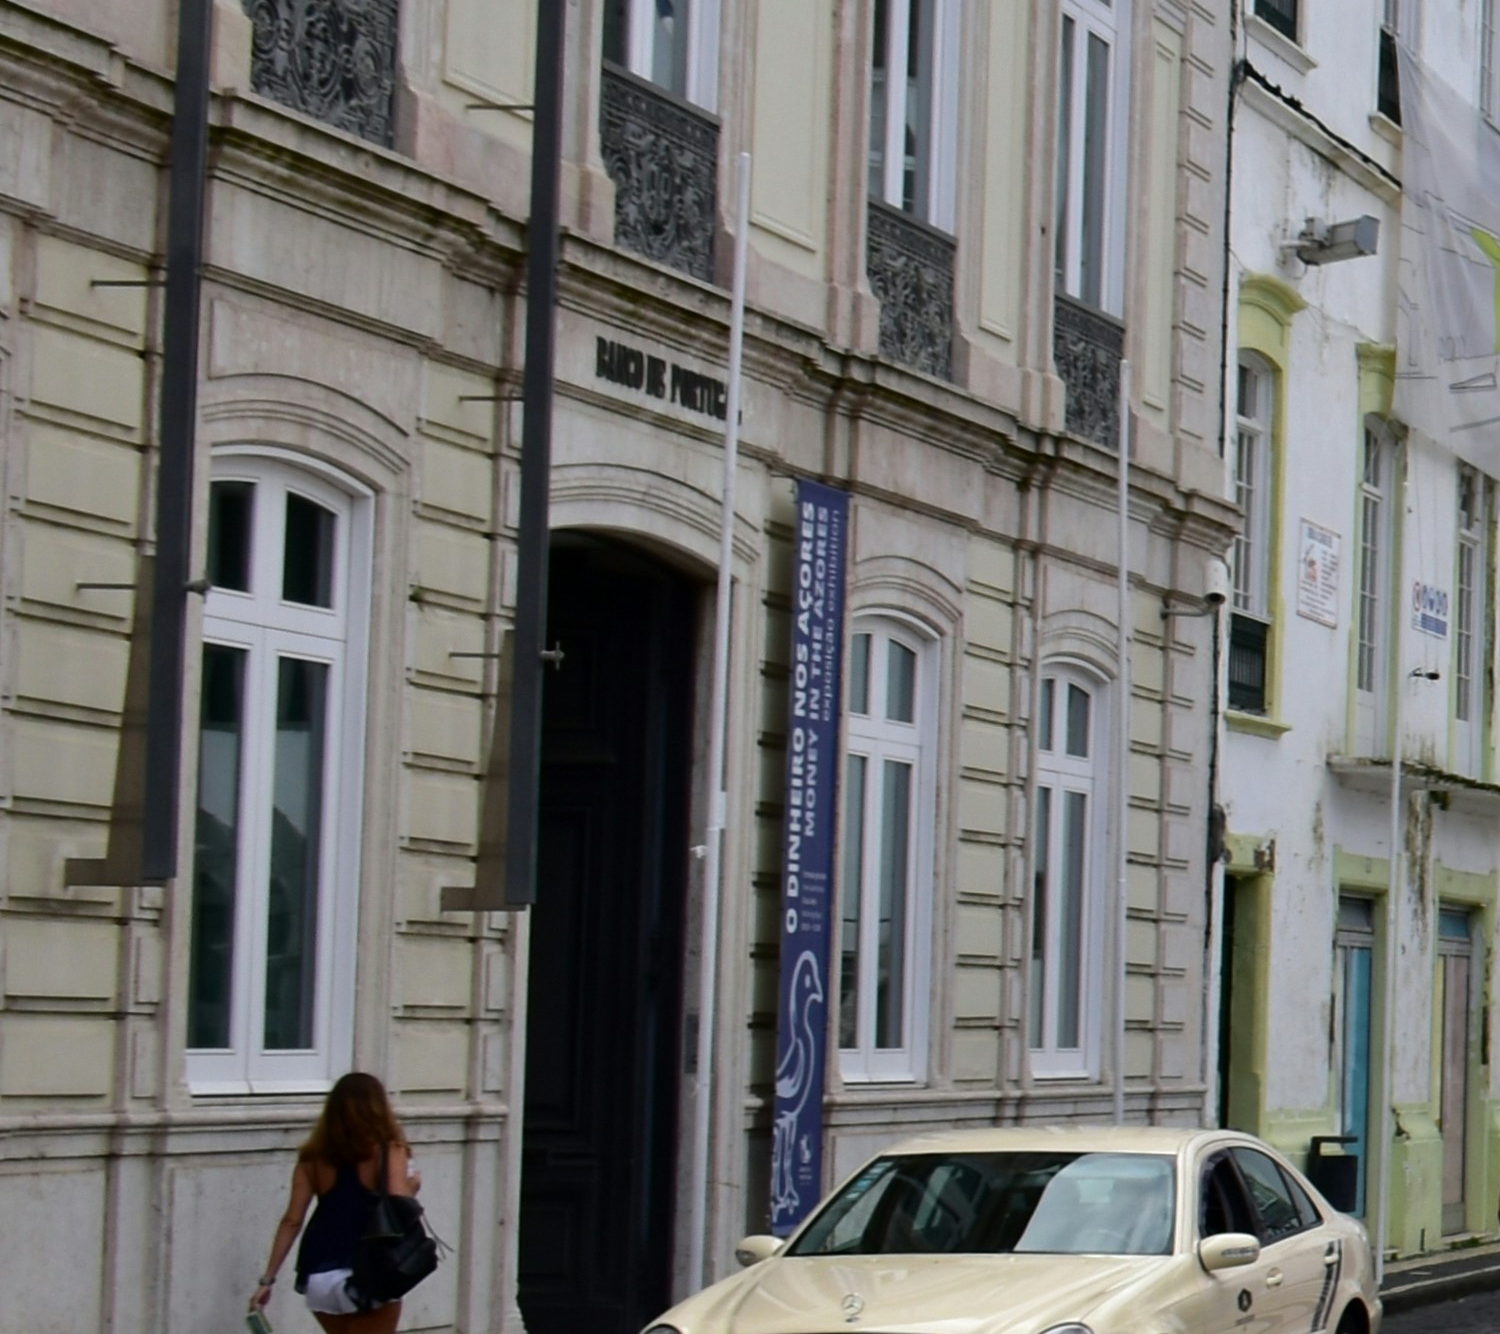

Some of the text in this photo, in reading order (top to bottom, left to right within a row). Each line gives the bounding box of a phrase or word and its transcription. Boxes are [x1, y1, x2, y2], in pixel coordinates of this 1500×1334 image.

[596, 336, 644, 390] BANCO
[646, 354, 666, 399] DE
[798, 502, 815, 635] AÇORES
[794, 643, 808, 716] NOS
[804, 507, 829, 837] MONEY IN THE AZORES
[787, 727, 805, 898] DINHEIRO
